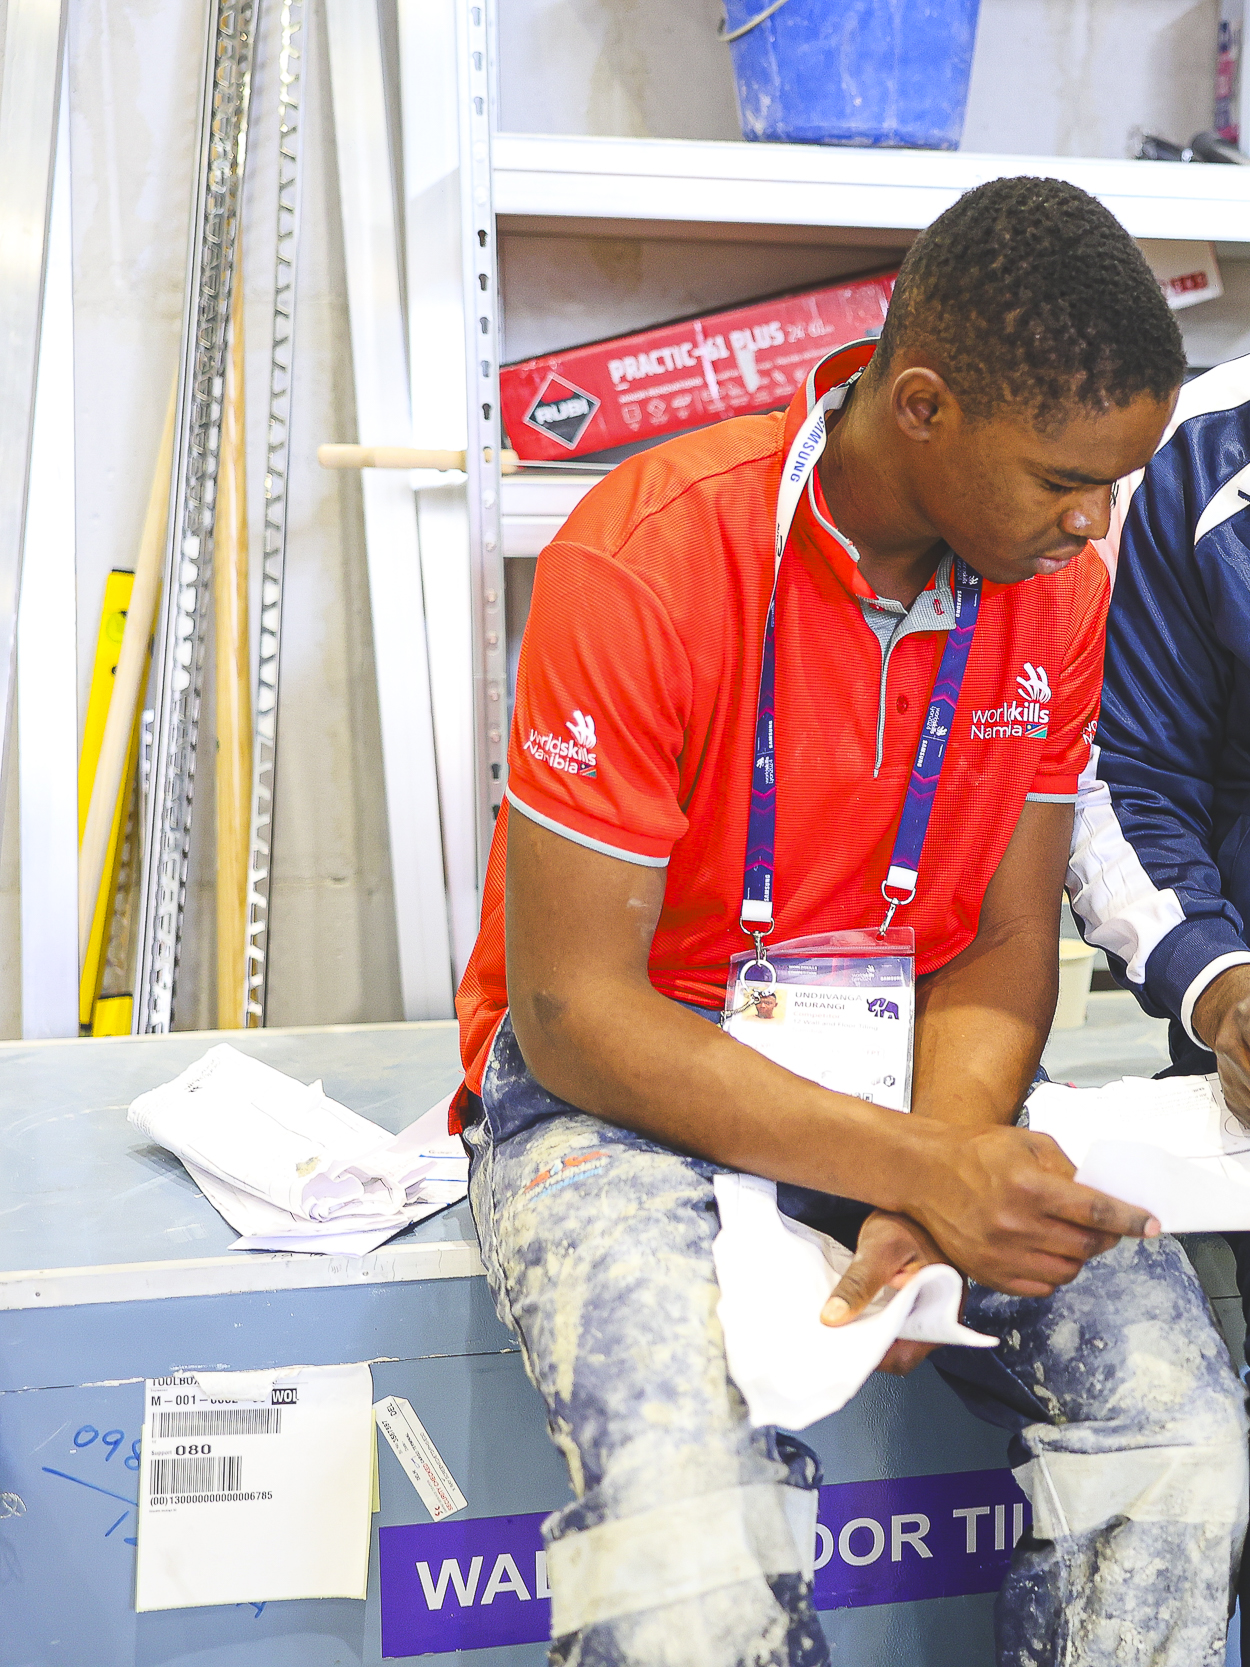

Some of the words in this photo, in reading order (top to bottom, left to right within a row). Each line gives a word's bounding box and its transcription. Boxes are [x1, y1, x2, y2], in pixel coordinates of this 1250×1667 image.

[535, 396, 588, 426] RUBI
[790, 415, 825, 483] SAMSUNG
[917, 739, 928, 768] SAMSUNG
[794, 1001, 845, 1010] MURANGI
[151, 1395, 161, 1407] M
[175, 1394, 196, 1406] 001
[175, 1443, 212, 1456] 080
